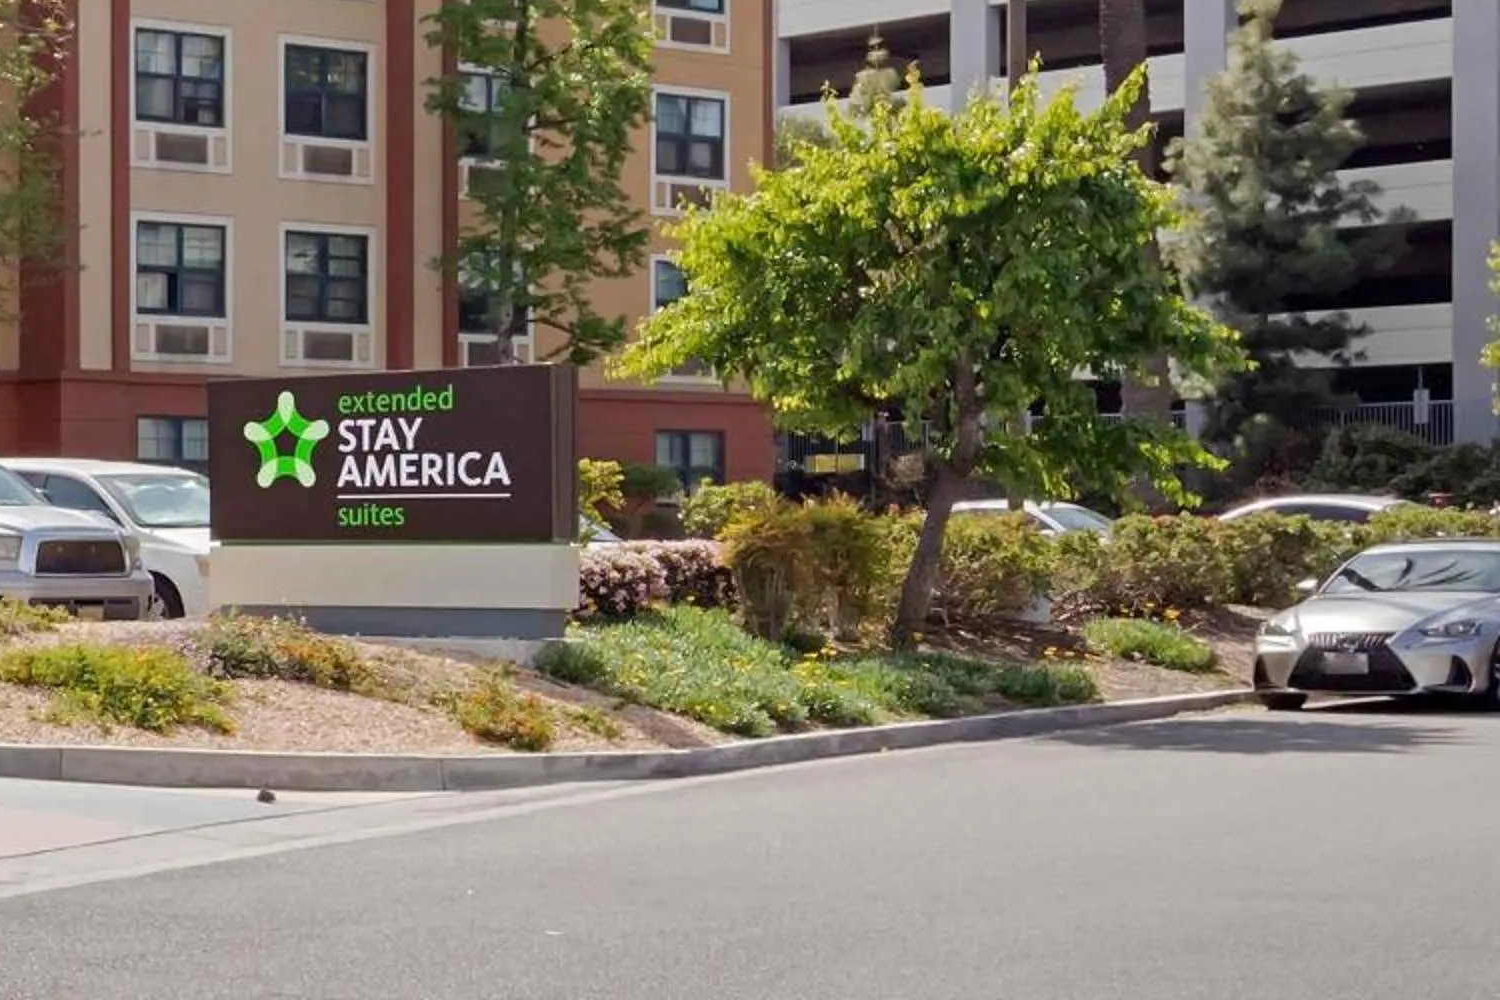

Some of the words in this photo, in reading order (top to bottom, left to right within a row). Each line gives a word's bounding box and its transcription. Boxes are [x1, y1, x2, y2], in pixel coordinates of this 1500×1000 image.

[338, 385, 453, 414] extended
[337, 418, 423, 452] STAY
[337, 452, 510, 487] AMERICA
[338, 503, 405, 527] suites
